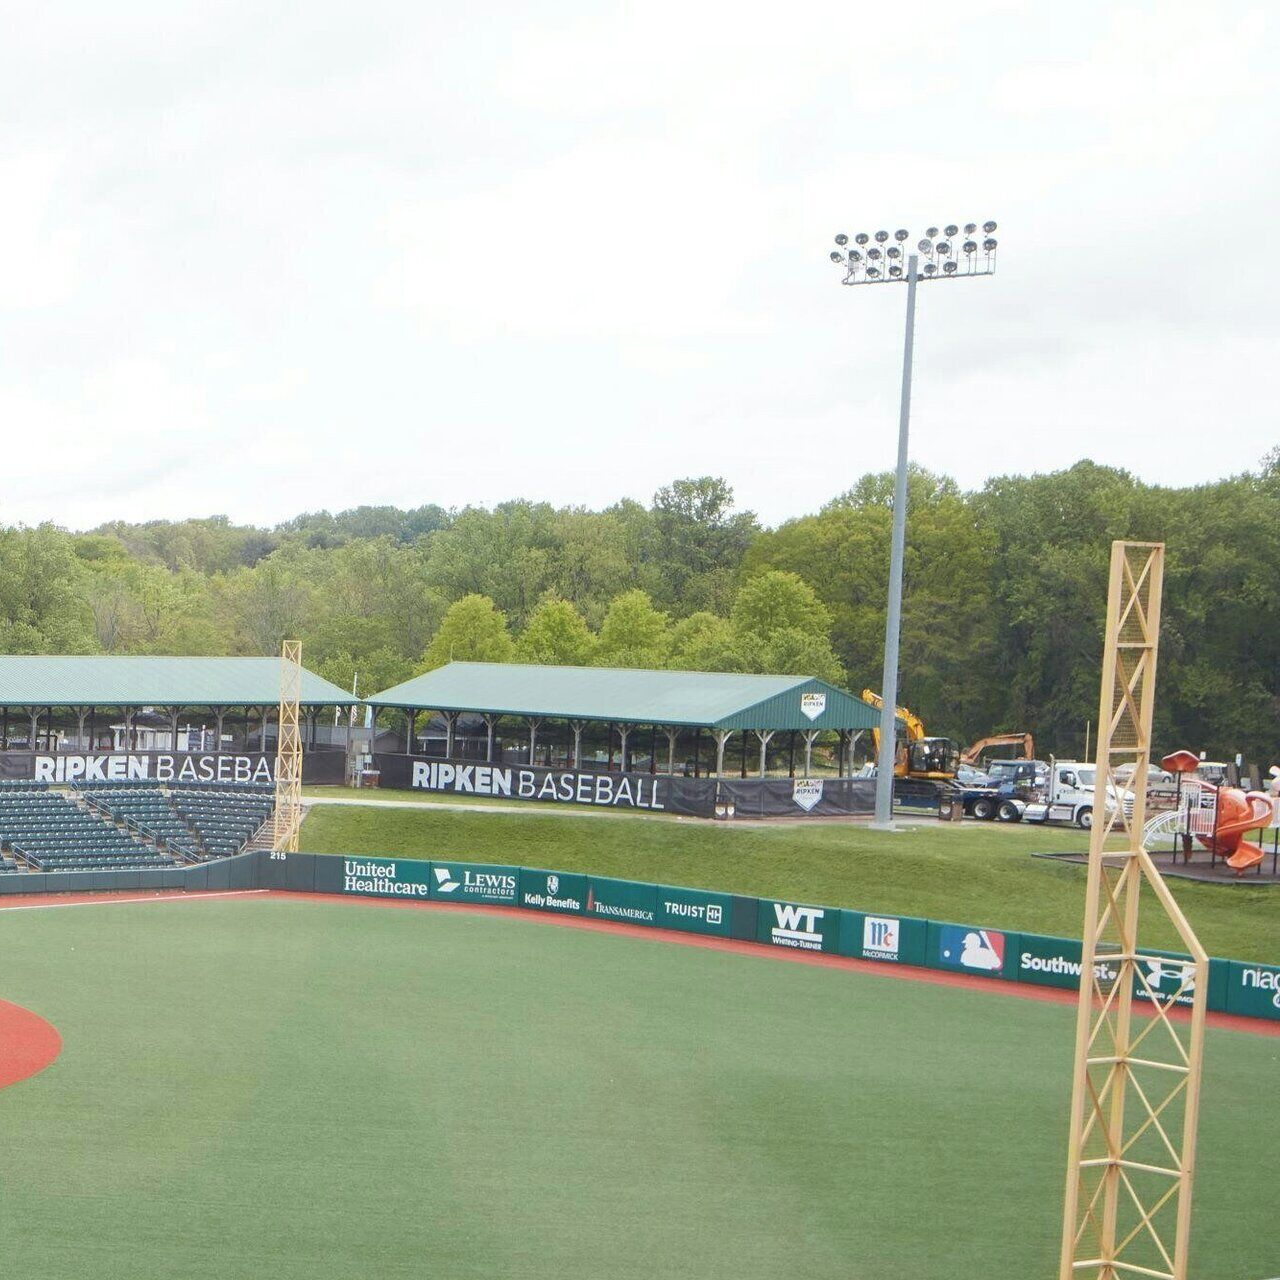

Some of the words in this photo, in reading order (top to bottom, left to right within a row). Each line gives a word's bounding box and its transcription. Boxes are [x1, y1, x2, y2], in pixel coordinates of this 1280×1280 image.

[34, 755, 150, 782] RIPKEN
[412, 761, 512, 796] RIPKEN
[518, 770, 665, 809] BASEBALL
[270, 852, 287, 860] 215
[344, 861, 396, 878] United
[344, 876, 428, 896] Healthcare
[464, 871, 516, 889] LEWIS
[464, 886, 515, 896] contractors
[524, 893, 546, 907] Kelly
[546, 896, 581, 910] Benefits
[594, 901, 654, 921] TRANSAMERICA
[664, 902, 706, 918] TRUIST
[773, 903, 824, 933] WT
[1020, 952, 1108, 980] Southwst
